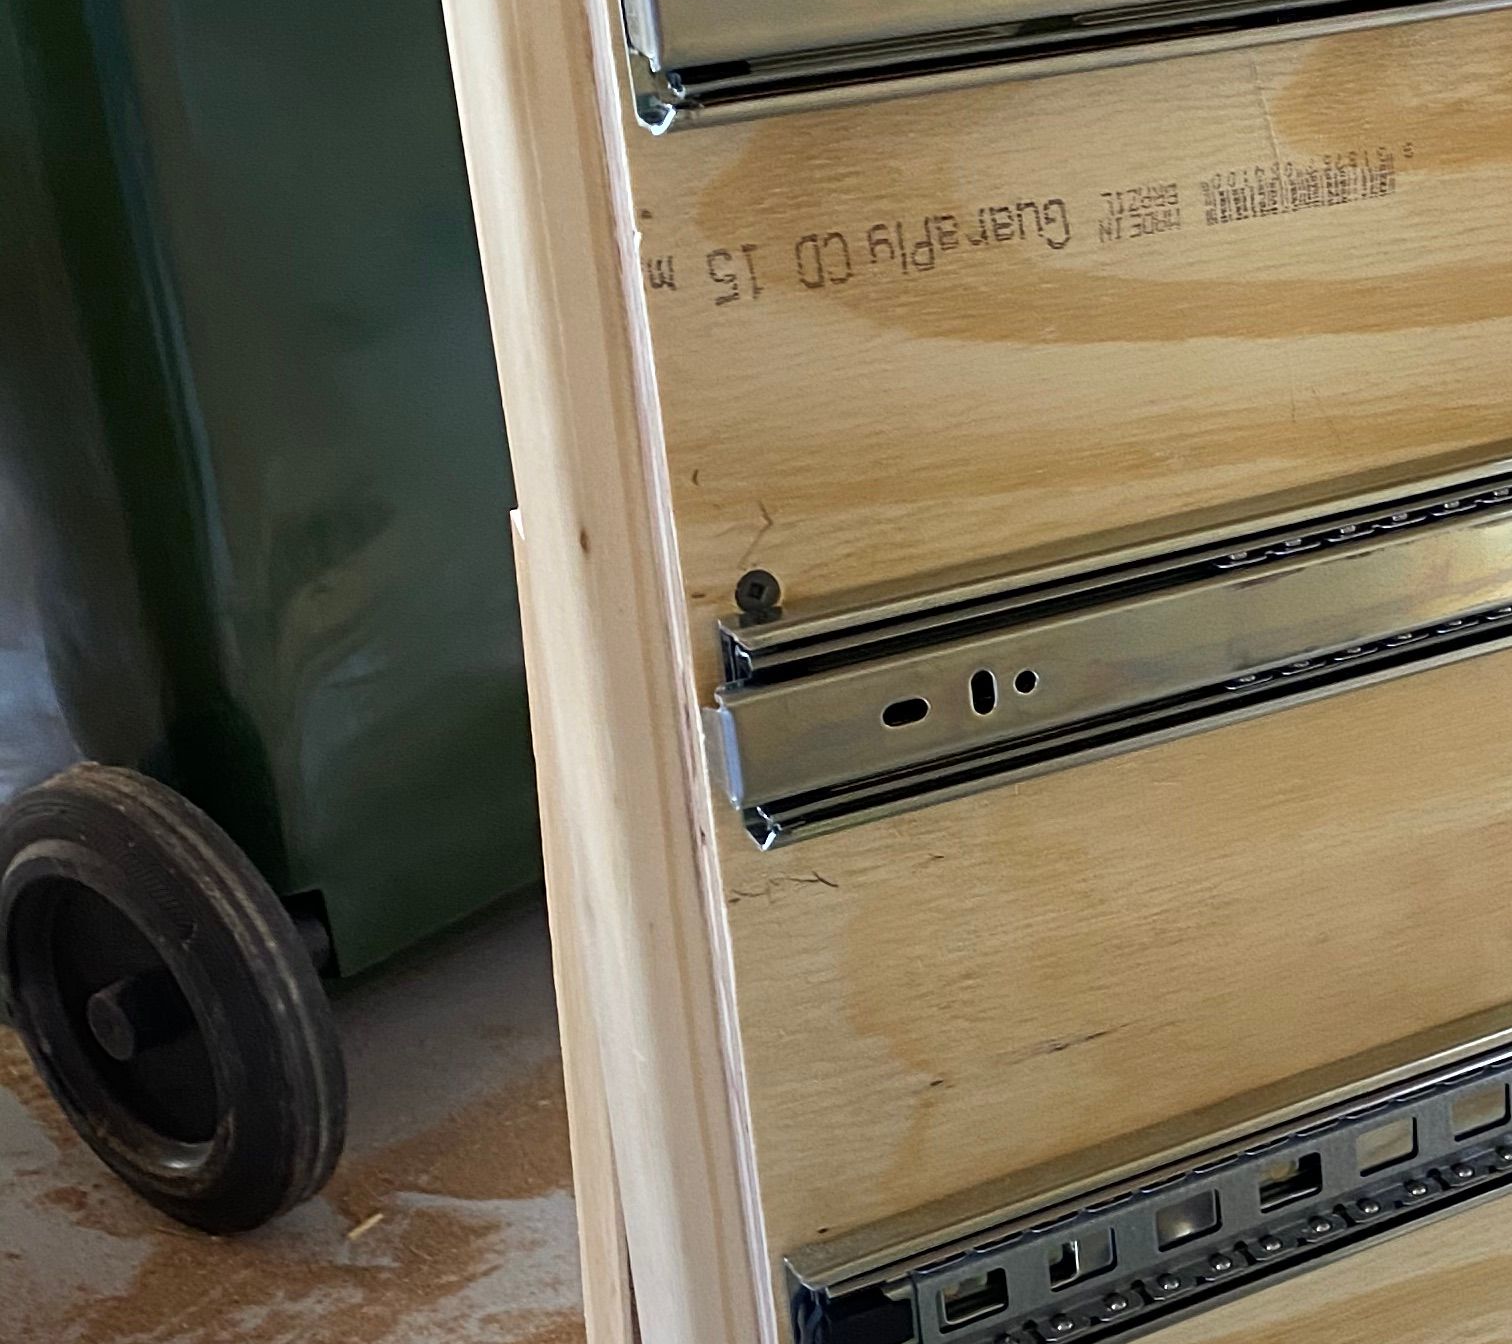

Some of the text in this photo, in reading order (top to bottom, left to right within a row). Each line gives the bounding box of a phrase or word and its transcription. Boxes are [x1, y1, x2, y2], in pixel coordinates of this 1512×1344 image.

[866, 198, 1071, 276] GuaraPly
[1098, 207, 1181, 244] MADE IN
[706, 243, 763, 307] 15
[795, 231, 854, 289] CD
